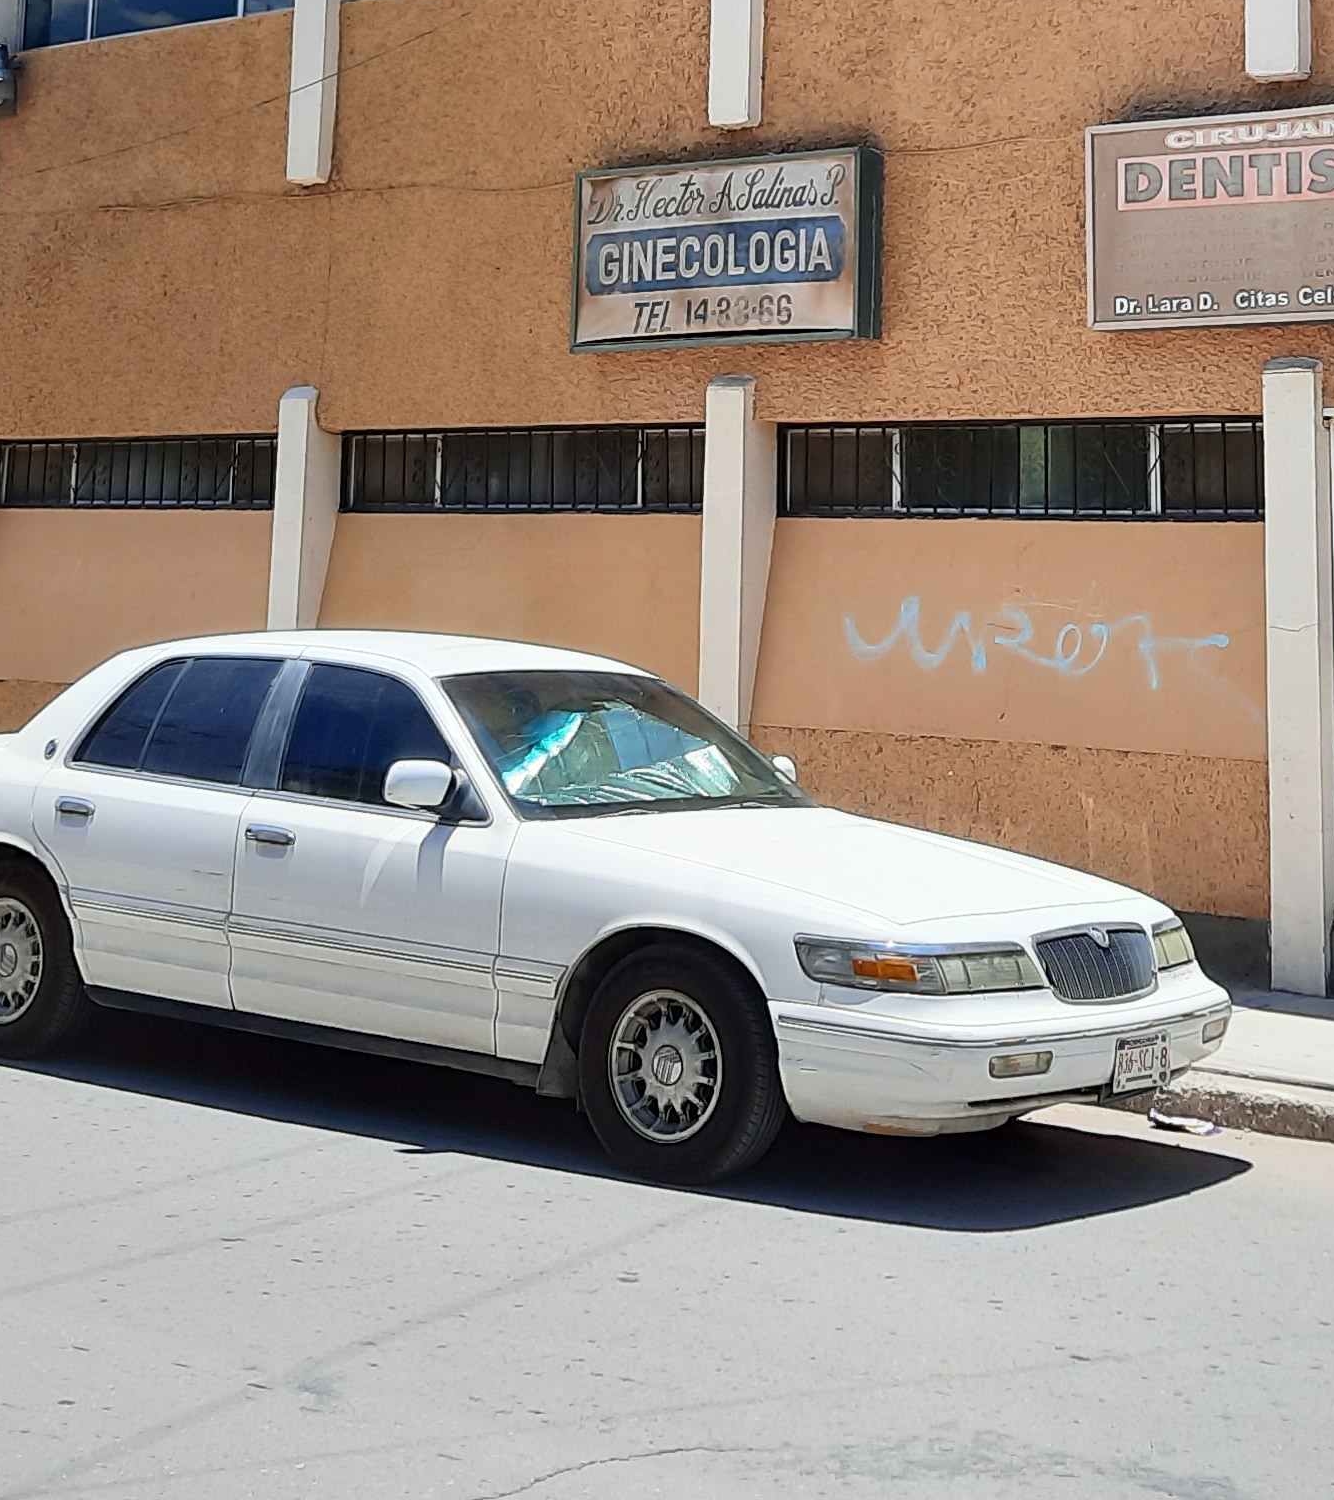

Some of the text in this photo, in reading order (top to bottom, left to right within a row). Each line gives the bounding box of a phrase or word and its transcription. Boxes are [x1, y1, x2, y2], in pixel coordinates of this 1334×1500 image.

[626, 174, 705, 221] Hector
[735, 166, 817, 211] Salinas
[597, 226, 833, 286] GINECOLOGIA
[632, 300, 672, 334] TEL
[1114, 297, 1142, 315] Dr.
[1147, 294, 1192, 312] Lara
[1198, 291, 1219, 310] D.
[1234, 290, 1290, 308] Citas
